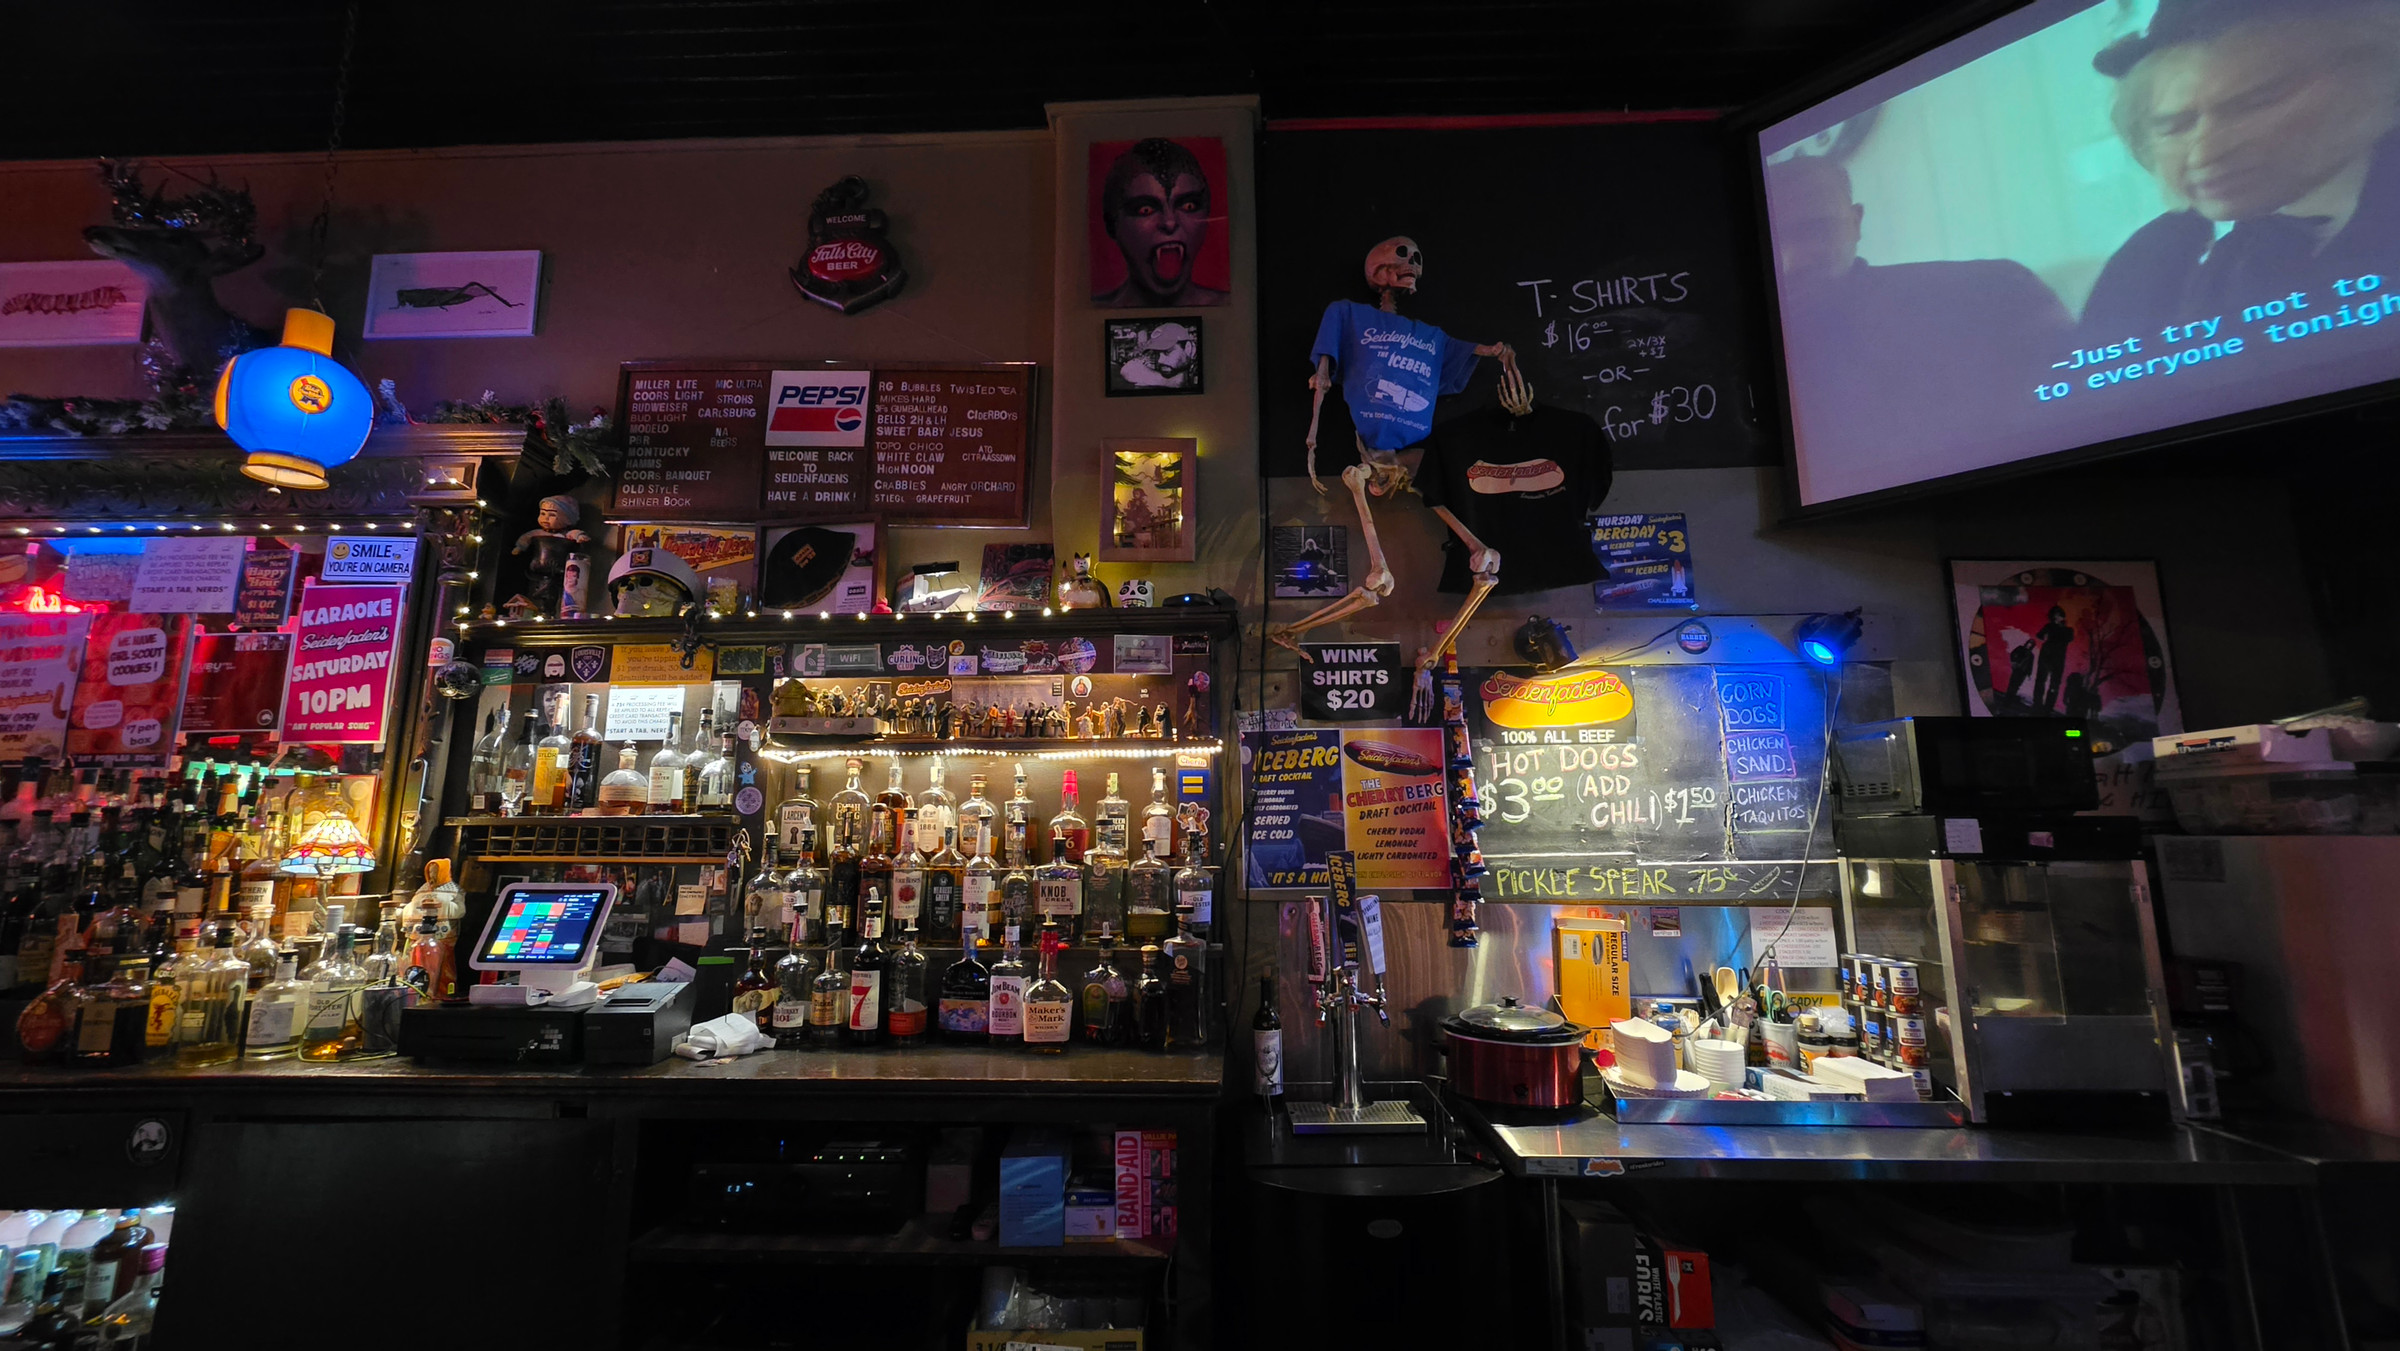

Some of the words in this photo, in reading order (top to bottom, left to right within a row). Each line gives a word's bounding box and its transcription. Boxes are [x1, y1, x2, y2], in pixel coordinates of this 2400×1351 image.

[826, 214, 866, 224] WELCOME
[811, 242, 846, 263] Falls
[846, 242, 878, 264] City
[827, 261, 858, 271] BEER
[2160, 315, 2221, 345] try
[2242, 290, 2310, 323] not
[2331, 273, 2382, 299] to
[1388, 352, 1432, 379] ICEBERG
[2033, 381, 2070, 402] to
[2086, 335, 2245, 391] everyone
[635, 380, 670, 390] MILLER
[676, 379, 698, 389] LITE
[715, 379, 733, 389] MIC
[736, 380, 763, 389] ULTRA
[879, 381, 894, 392] RG
[901, 381, 941, 392] BUBBLES
[950, 383, 996, 395] TWISTED
[998, 386, 1017, 395] TEA
[633, 391, 669, 401] COORS
[675, 391, 704, 400] LIGHT
[717, 395, 754, 404] STROHS
[778, 385, 867, 405] PEPSI
[880, 395, 910, 403] MIKES
[911, 395, 936, 404] HARD
[632, 403, 688, 412] BUDWEISER
[891, 404, 948, 414] GUMBALLHEAD
[1602, 405, 1645, 442] for
[1649, 383, 1717, 425] $30
[630, 413, 651, 423] BUD
[657, 413, 687, 422] LIGHT
[877, 414, 906, 424] BELLS
[910, 415, 924, 425] 2H
[925, 416, 932, 425] &
[934, 415, 947, 425] LH
[967, 410, 1018, 421] CIDERBOYS
[1375, 412, 1395, 422] totally
[630, 424, 669, 434] MODELO
[876, 426, 912, 437] SWEET
[918, 426, 945, 437] BABY
[950, 427, 983, 438] JESUS
[629, 436, 650, 445] PBR
[710, 437, 738, 447] BEERS
[875, 441, 901, 451] TOPO
[909, 442, 943, 451] CHICO
[628, 447, 690, 457] MONTUCKY
[769, 451, 819, 461] WELCOME
[828, 451, 854, 461] BACK
[877, 452, 910, 462] WHITE
[916, 452, 945, 463] CLAW
[626, 459, 662, 469] HAMMS
[803, 463, 817, 473] TO
[624, 471, 661, 481] COORS
[665, 470, 712, 480] BANQUET
[774, 473, 849, 484] SEIDENFADENS
[622, 484, 644, 494] OLD
[648, 484, 679, 494] STYLE
[874, 480, 926, 490] CRABBIES
[941, 483, 968, 491] ANGRY
[971, 481, 1015, 492] ORCHARD
[621, 497, 659, 507] SHINER
[664, 496, 691, 507] BOCK
[768, 491, 797, 501] HAVE
[802, 491, 809, 501] A
[916, 494, 972, 504] GRAPEFRUIT
[1594, 525, 1656, 542] BERGDAY
[1609, 541, 1635, 550] ICEBERG
[1657, 530, 1687, 553] $3
[351, 544, 393, 558] SMILE
[249, 568, 287, 579] Happy
[328, 562, 358, 573] YOU'RE
[359, 562, 372, 572] ON
[374, 562, 410, 574] CAMERA
[1635, 564, 1669, 576] ICEBERG
[249, 578, 279, 587] Hour
[259, 600, 276, 609] Off
[302, 598, 393, 628] KARAOKE
[300, 626, 389, 651] Seidenfaden's
[131, 647, 165, 659] SCOUT
[575, 649, 602, 659] LOUISVILLE
[1322, 649, 1378, 664] WINK
[888, 655, 924, 664] CURLING
[292, 650, 390, 683] SATURDAY
[898, 663, 914, 671] CLUB
[1312, 669, 1389, 686] SHIRTS
[1721, 682, 1774, 704] CORN
[299, 684, 372, 716] 10PM
[1326, 689, 1376, 711] $20
[1726, 703, 1778, 725] DOGS
[137, 723, 158, 735] per
[309, 722, 344, 730] POPULAR
[130, 737, 152, 746] box
[1501, 731, 1538, 744] 100%
[1544, 731, 1572, 743] ALL
[1579, 729, 1616, 743] BEEF
[1727, 737, 1785, 754] CHICKEN
[1252, 745, 1339, 773] ICEBERG
[1490, 749, 1545, 781] HOT
[1559, 743, 1639, 772] DOGS
[1278, 771, 1313, 782] COCKTAIL
[1360, 778, 1381, 789] THE
[1346, 781, 1445, 808] CHERRYBERG
[1737, 785, 1798, 806] CHICKEN
[784, 810, 808, 821] LARCENY
[1359, 807, 1390, 821] DRAFT
[1393, 801, 1437, 815] COCKTAIL
[1740, 805, 1806, 825] TAQUITOS
[1254, 815, 1291, 826] SERVED
[1252, 830, 1268, 840] ICE
[1269, 829, 1294, 840] COLD
[1367, 827, 1397, 836] CHERRY
[1399, 827, 1426, 836] VODKA
[1375, 840, 1419, 848] LEMONADE
[1386, 851, 1438, 860] CARBONATED
[1343, 861, 1355, 879] THE
[1298, 871, 1307, 883] A
[1328, 854, 1350, 908] ICEBERG
[1496, 867, 1581, 897] PICKLE
[1588, 866, 1677, 897] SPEAR
[1041, 886, 1067, 898] KNOB
[1610, 932, 1620, 974] REGULAR
[991, 985, 1002, 996] JIM
[1002, 982, 1021, 996] BEAM
[1611, 976, 1620, 997] SIZE
[852, 985, 872, 1027] 7
[1028, 1006, 1066, 1015] Maker's
[775, 1015, 791, 1023] 101
[992, 1010, 1018, 1019] BOURBON
[1037, 1014, 1065, 1022] Mark
[1117, 1135, 1139, 1228] BAND-AID
[1651, 1267, 1662, 1296] WHITE
[1635, 1254, 1654, 1322] FORKS
[1653, 1295, 1664, 1323] PLASTIC
